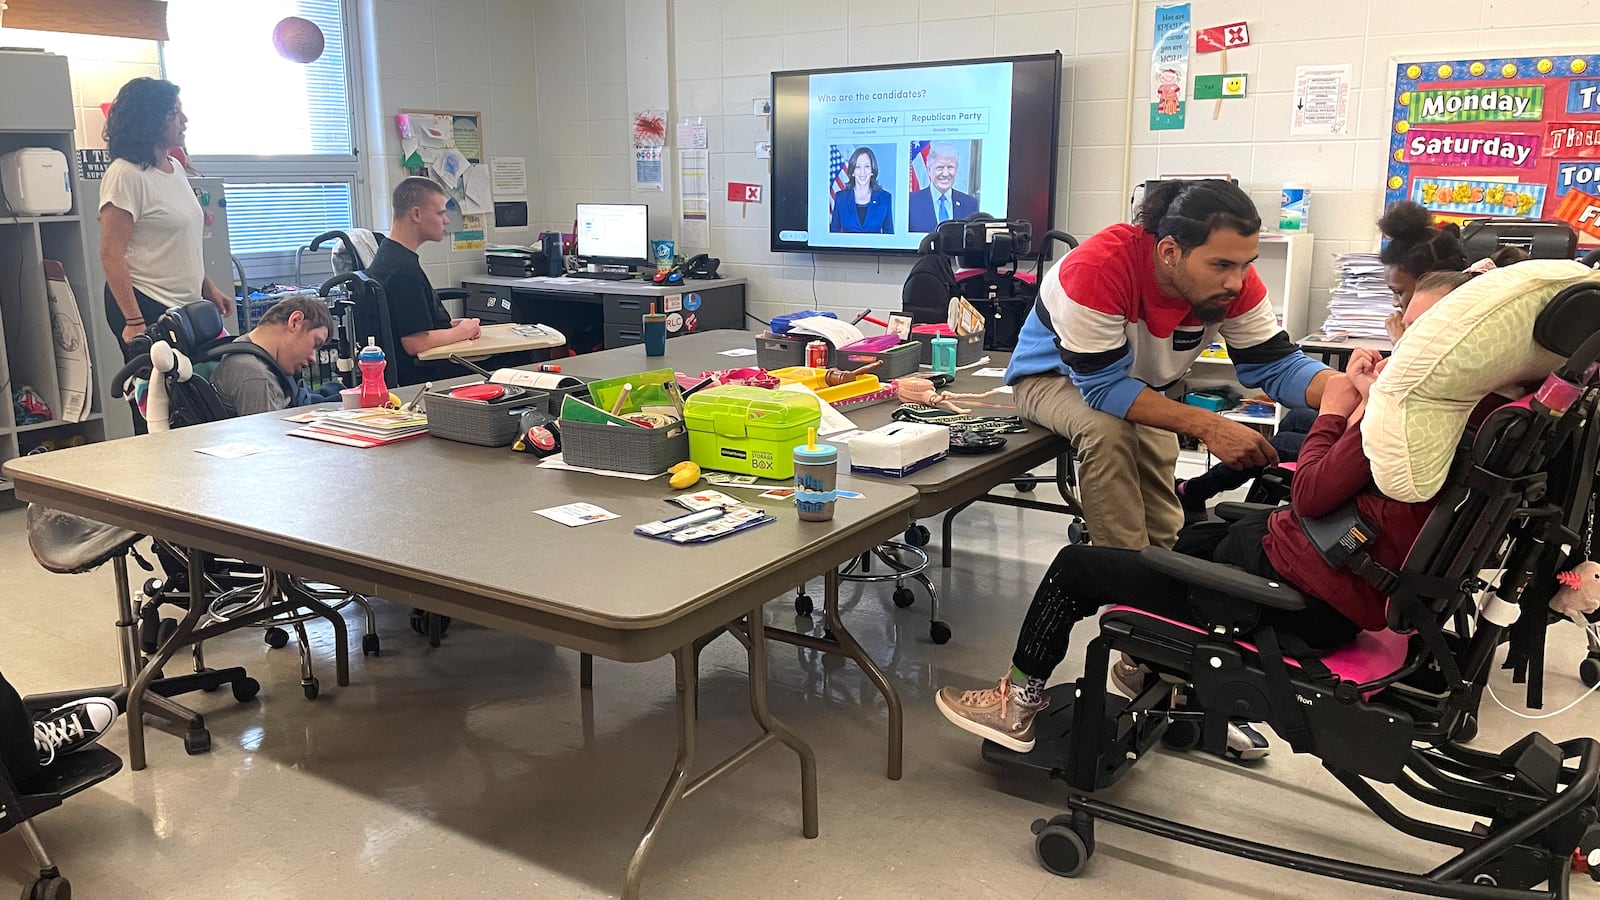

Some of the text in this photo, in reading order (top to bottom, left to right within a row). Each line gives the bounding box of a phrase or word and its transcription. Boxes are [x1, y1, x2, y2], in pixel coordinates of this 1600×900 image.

[818, 89, 927, 103] Who are the candidates?
[1422, 90, 1531, 118] Monday
[832, 115, 898, 125] Democratic Party
[911, 111, 982, 123] Republican Party
[1409, 136, 1532, 165] Saturday
[82, 151, 88, 163] I
[666, 317, 681, 328] RLC
[752, 459, 774, 471] BOX
